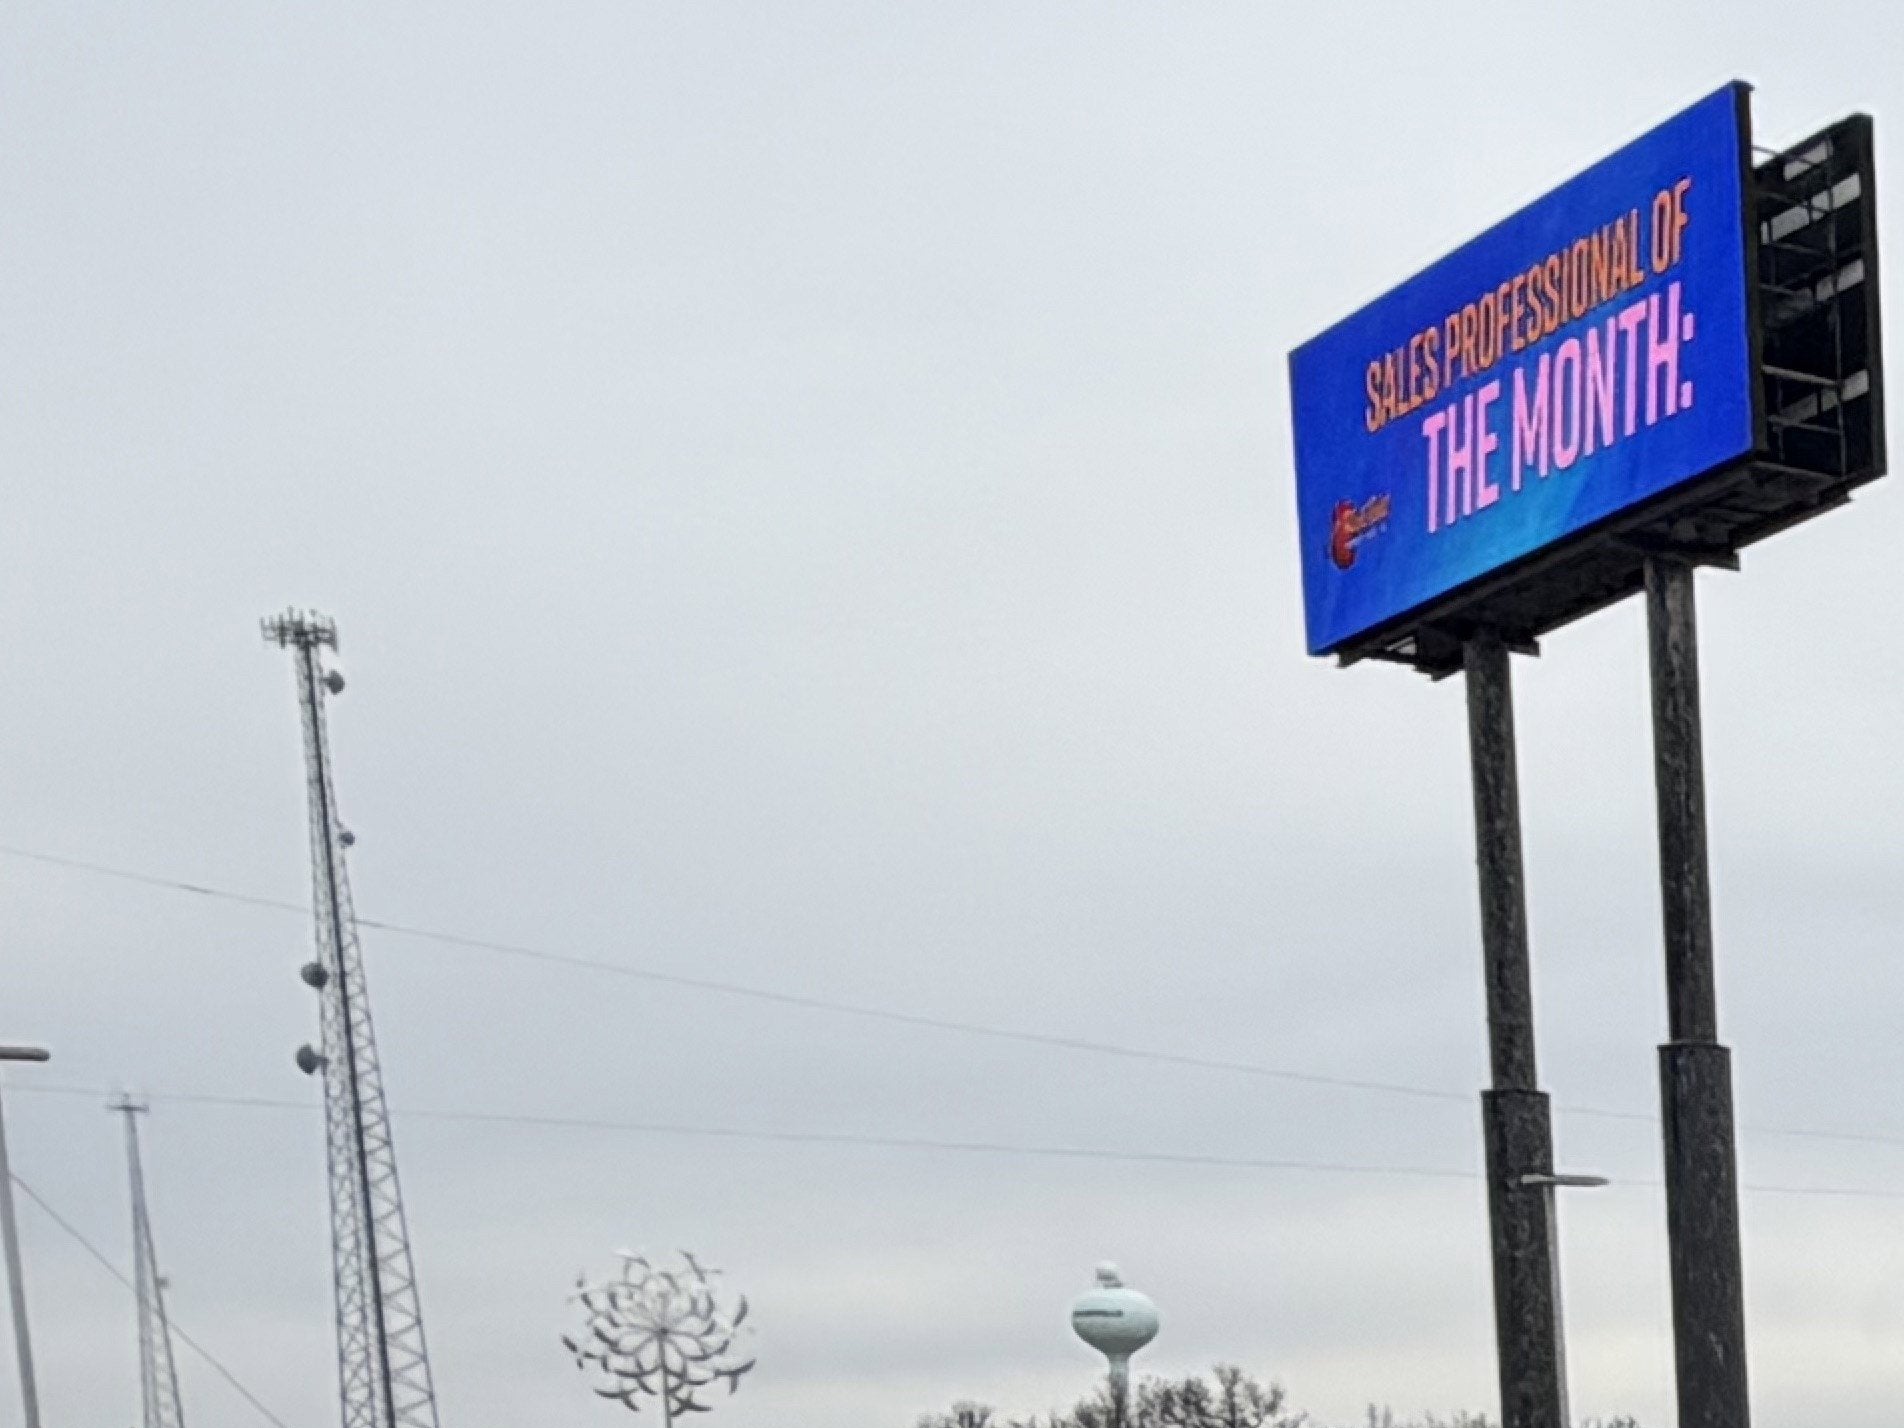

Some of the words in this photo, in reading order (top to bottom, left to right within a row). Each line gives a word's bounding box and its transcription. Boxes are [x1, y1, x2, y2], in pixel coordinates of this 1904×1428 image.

[1365, 325, 1440, 434] SALES
[1443, 207, 1645, 388] PROFESSIONAL
[1651, 175, 1692, 274] OF
[1422, 380, 1500, 535] THE
[1511, 280, 1694, 492] MONTH:
